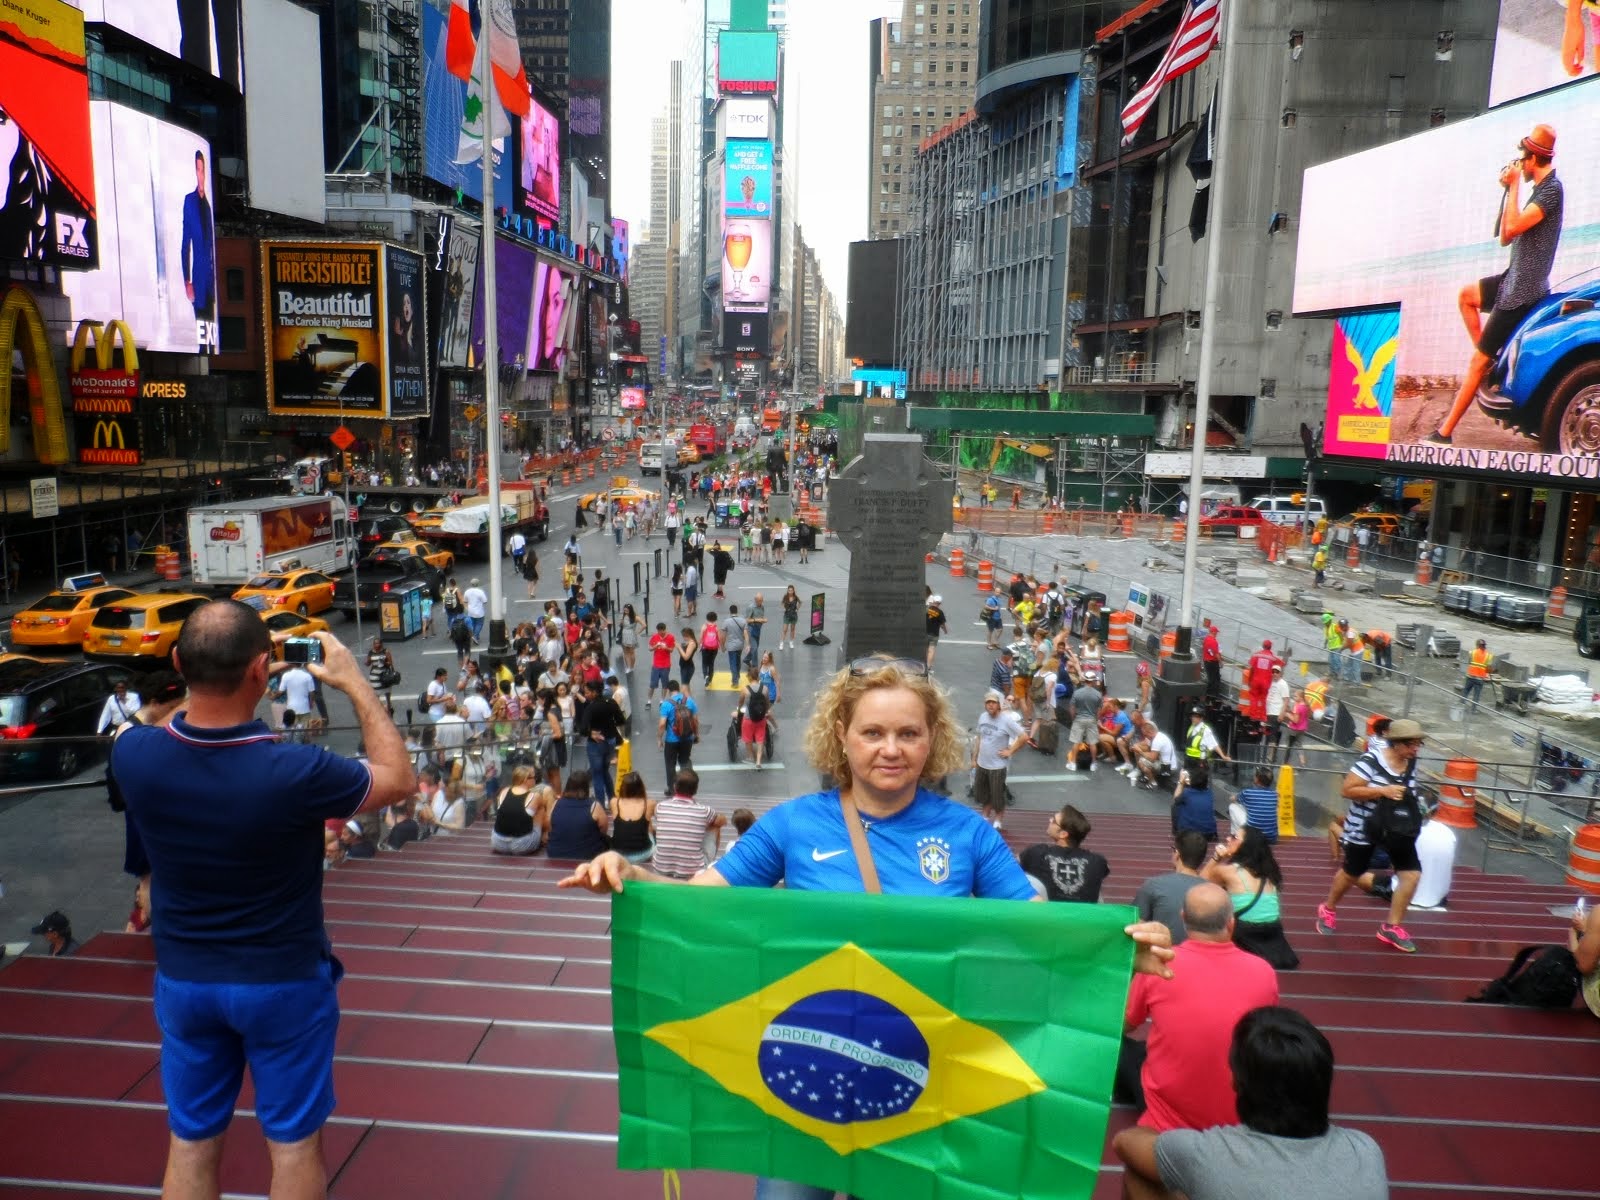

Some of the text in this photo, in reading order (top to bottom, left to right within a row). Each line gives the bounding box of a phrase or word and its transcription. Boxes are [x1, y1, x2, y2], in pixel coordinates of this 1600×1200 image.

[2, 0, 51, 27] Diane Kruger
[720, 81, 775, 91] TOSHIBA
[737, 114, 764, 123] TDK
[55, 212, 89, 249] FX
[57, 245, 90, 258] FEARLESS
[321, 252, 331, 262] THE
[332, 253, 351, 263] RANKS
[352, 254, 359, 263] OF
[360, 254, 371, 263] THE
[278, 290, 372, 317] Beautiful
[279, 317, 372, 329] The Carole King Musical
[71, 377, 136, 388] McDonald's
[394, 378, 423, 400] IF/THEN
[82, 387, 125, 395] Restaurant
[1387, 445, 1479, 469] AMERICAN
[1487, 451, 1552, 474] EAGLE
[771, 1027, 822, 1045] ORDEM
[829, 1038, 839, 1050] E
